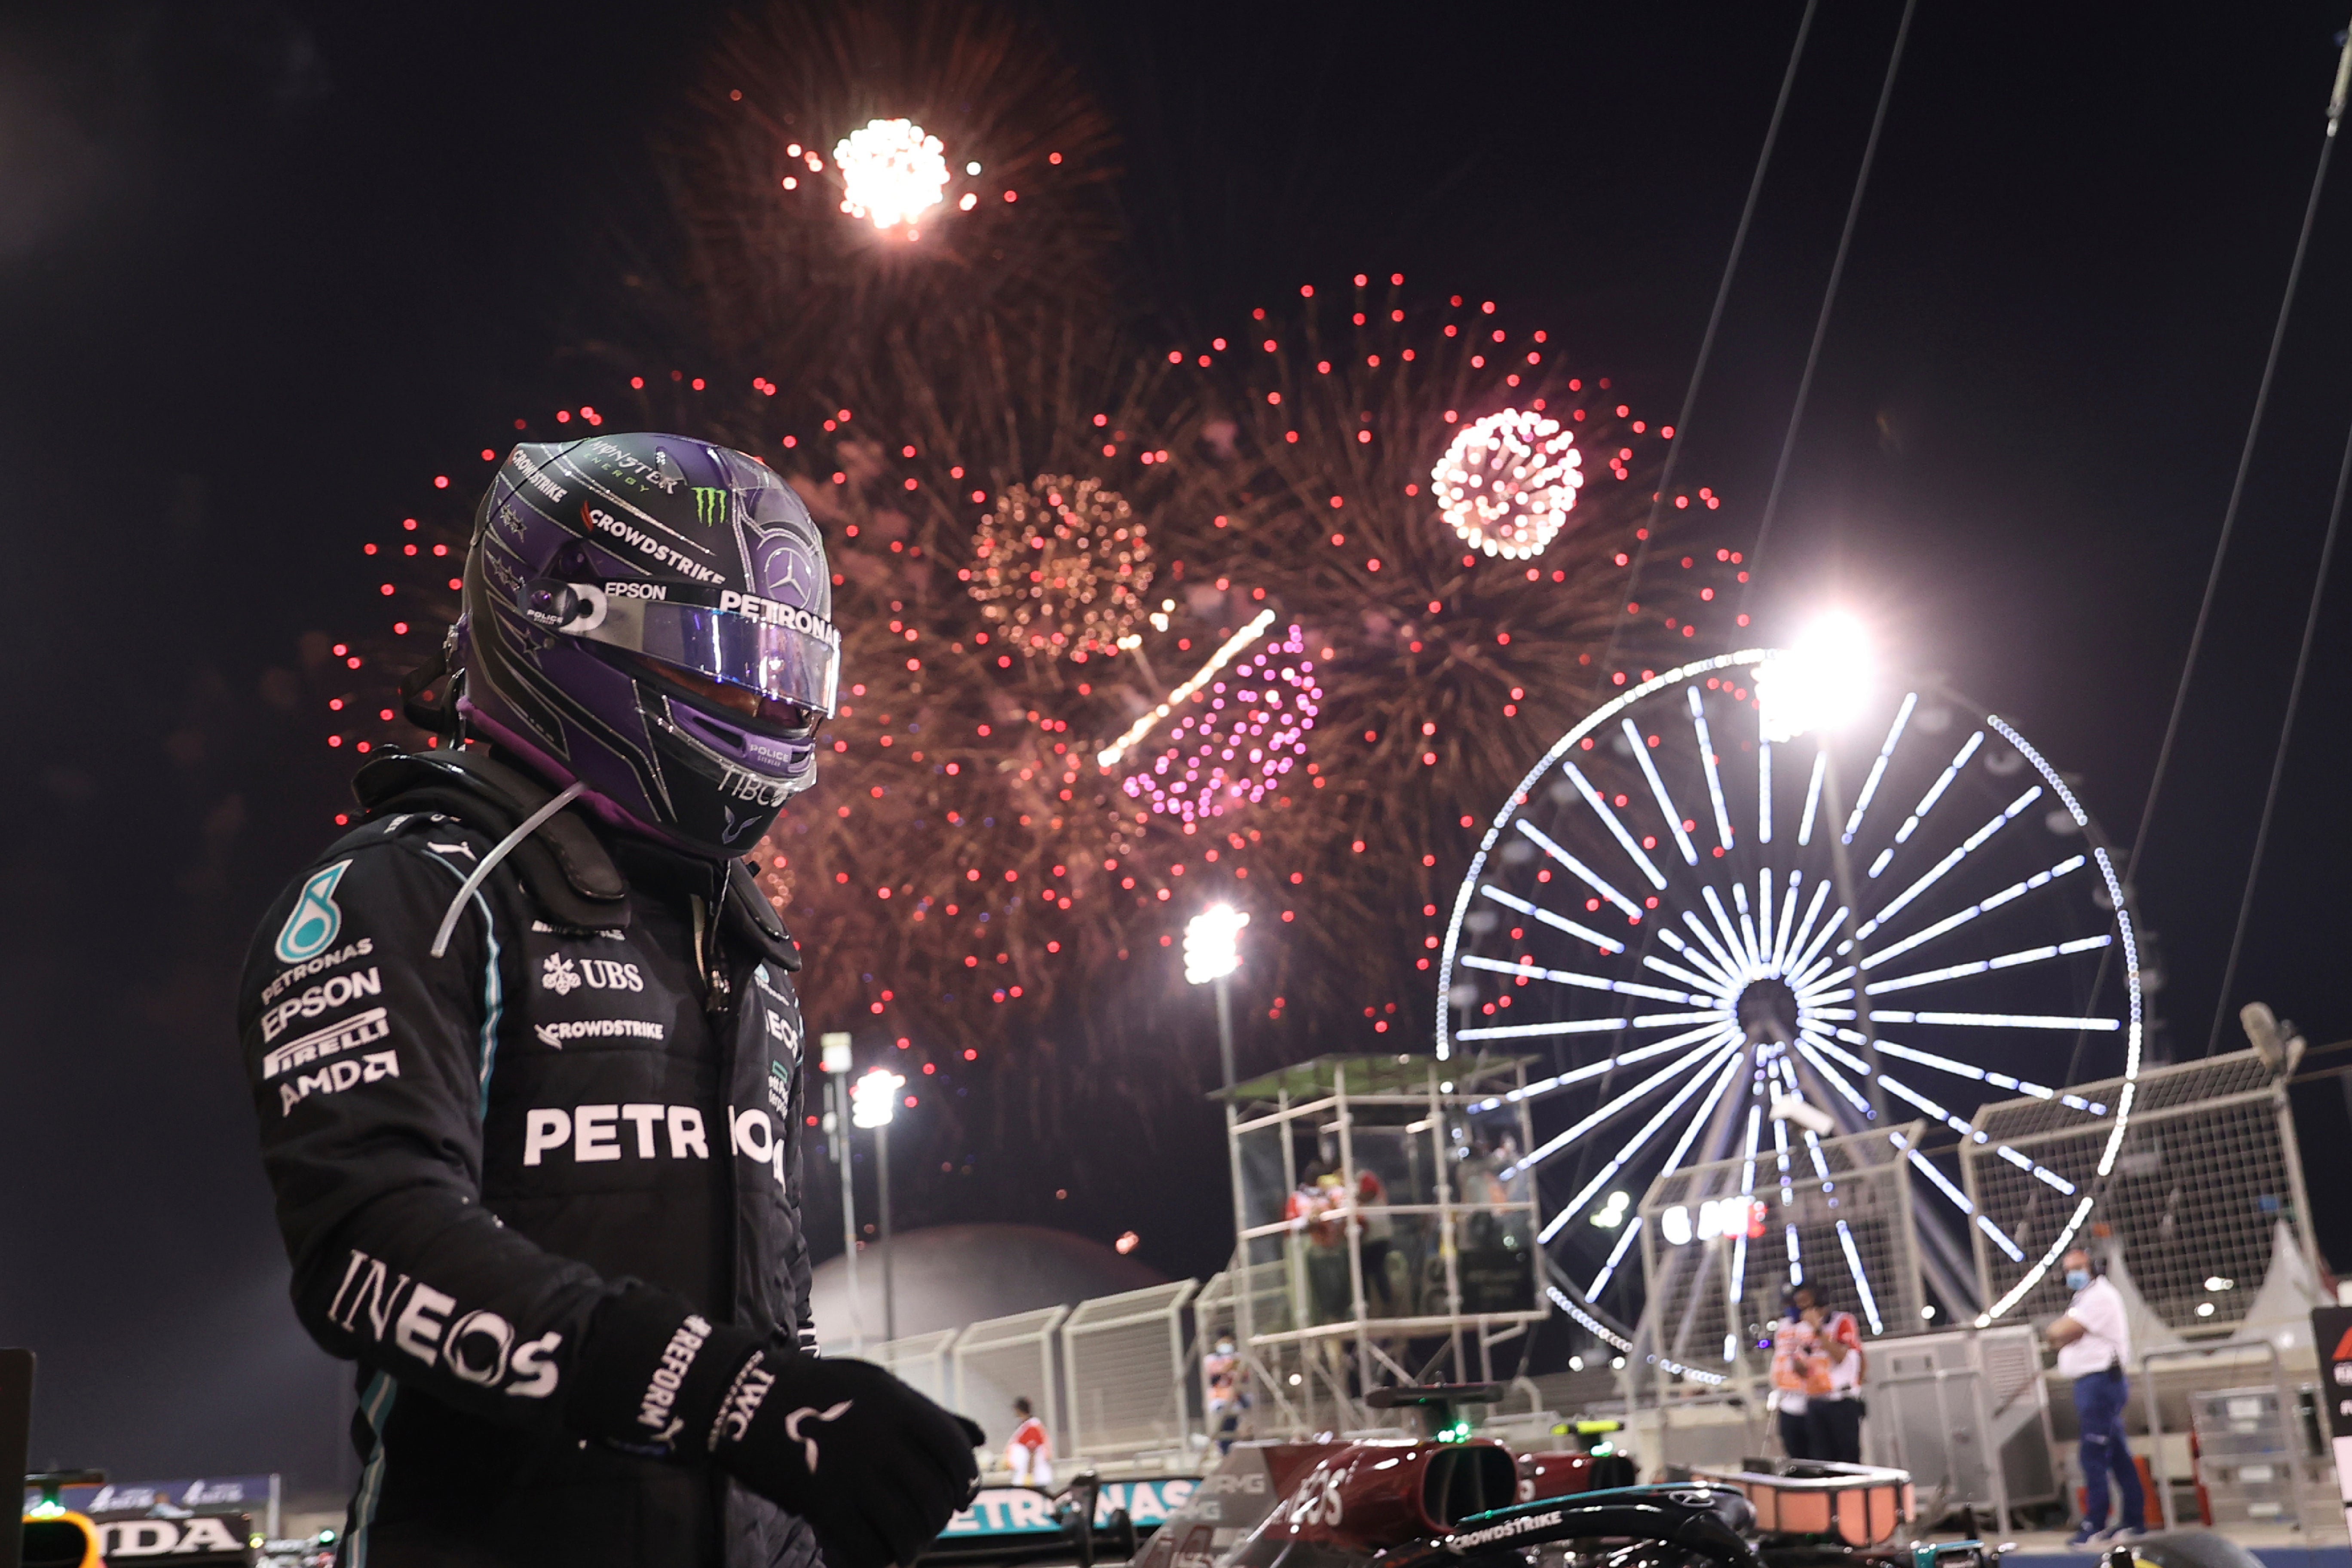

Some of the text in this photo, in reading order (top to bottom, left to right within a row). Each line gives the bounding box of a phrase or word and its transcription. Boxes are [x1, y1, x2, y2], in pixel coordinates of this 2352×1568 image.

[589, 509, 726, 585] CROWDSTRIKE
[527, 609, 564, 623] POLICE
[606, 582, 667, 600] EPSON
[720, 589, 834, 646] PETRONA
[750, 744, 789, 763] POLICE
[261, 937, 374, 1005] PETRONAS
[579, 959, 644, 992] UBS
[261, 967, 382, 1044] EPSON
[544, 1019, 665, 1041] CROWDSTRIKE
[263, 1007, 390, 1080] PIRELLI
[279, 1059, 362, 1118] AMD
[327, 1249, 563, 1398] INEOS
